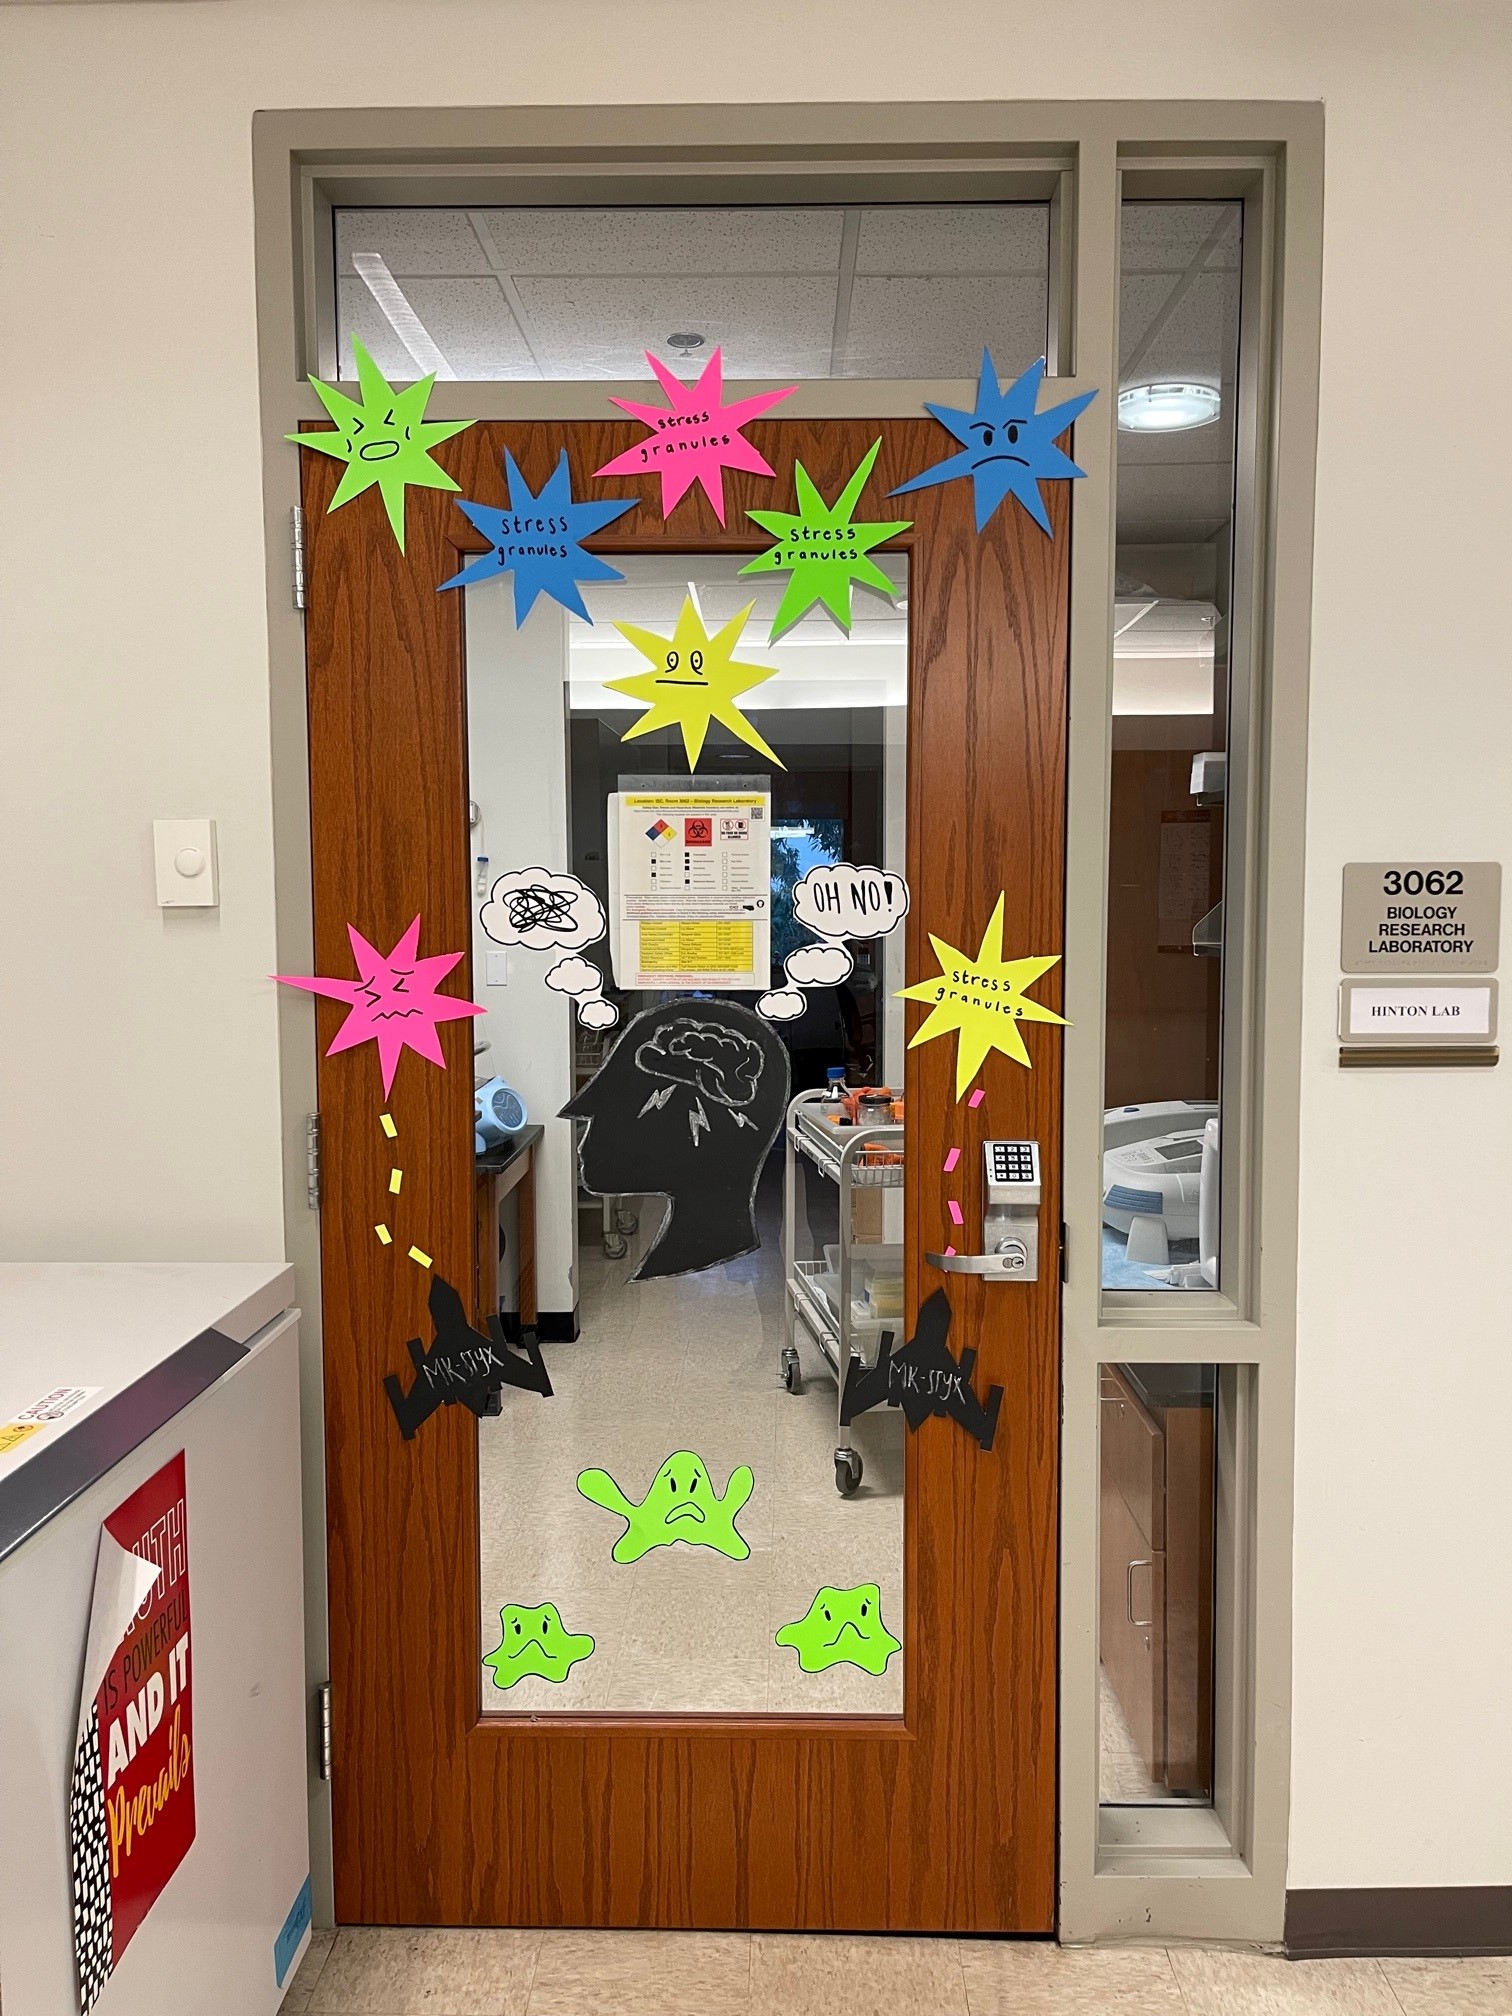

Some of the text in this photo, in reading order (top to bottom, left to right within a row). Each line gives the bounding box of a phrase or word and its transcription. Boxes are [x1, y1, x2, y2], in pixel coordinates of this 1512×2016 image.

[658, 411, 710, 429] stress
[641, 434, 731, 463] granules
[501, 515, 568, 535] stress
[790, 525, 856, 542] stress
[497, 543, 568, 566] granules
[774, 548, 858, 565] granules
[1383, 870, 1464, 896] 3062
[813, 880, 893, 916] OH NO!
[1387, 906, 1457, 919] BIOLOGY
[1379, 923, 1465, 936] RESEARCH
[1368, 940, 1474, 953] LABORATORY
[952, 969, 1011, 992] stress
[934, 987, 1023, 1016] granules
[1371, 1005, 1460, 1017] HINTON LAB
[18, 1388, 72, 1420] CAUTION
[103, 1593, 189, 1716] IS POWERFUL
[107, 1631, 189, 1790] AND IT
[107, 1703, 191, 1879] Prevails
